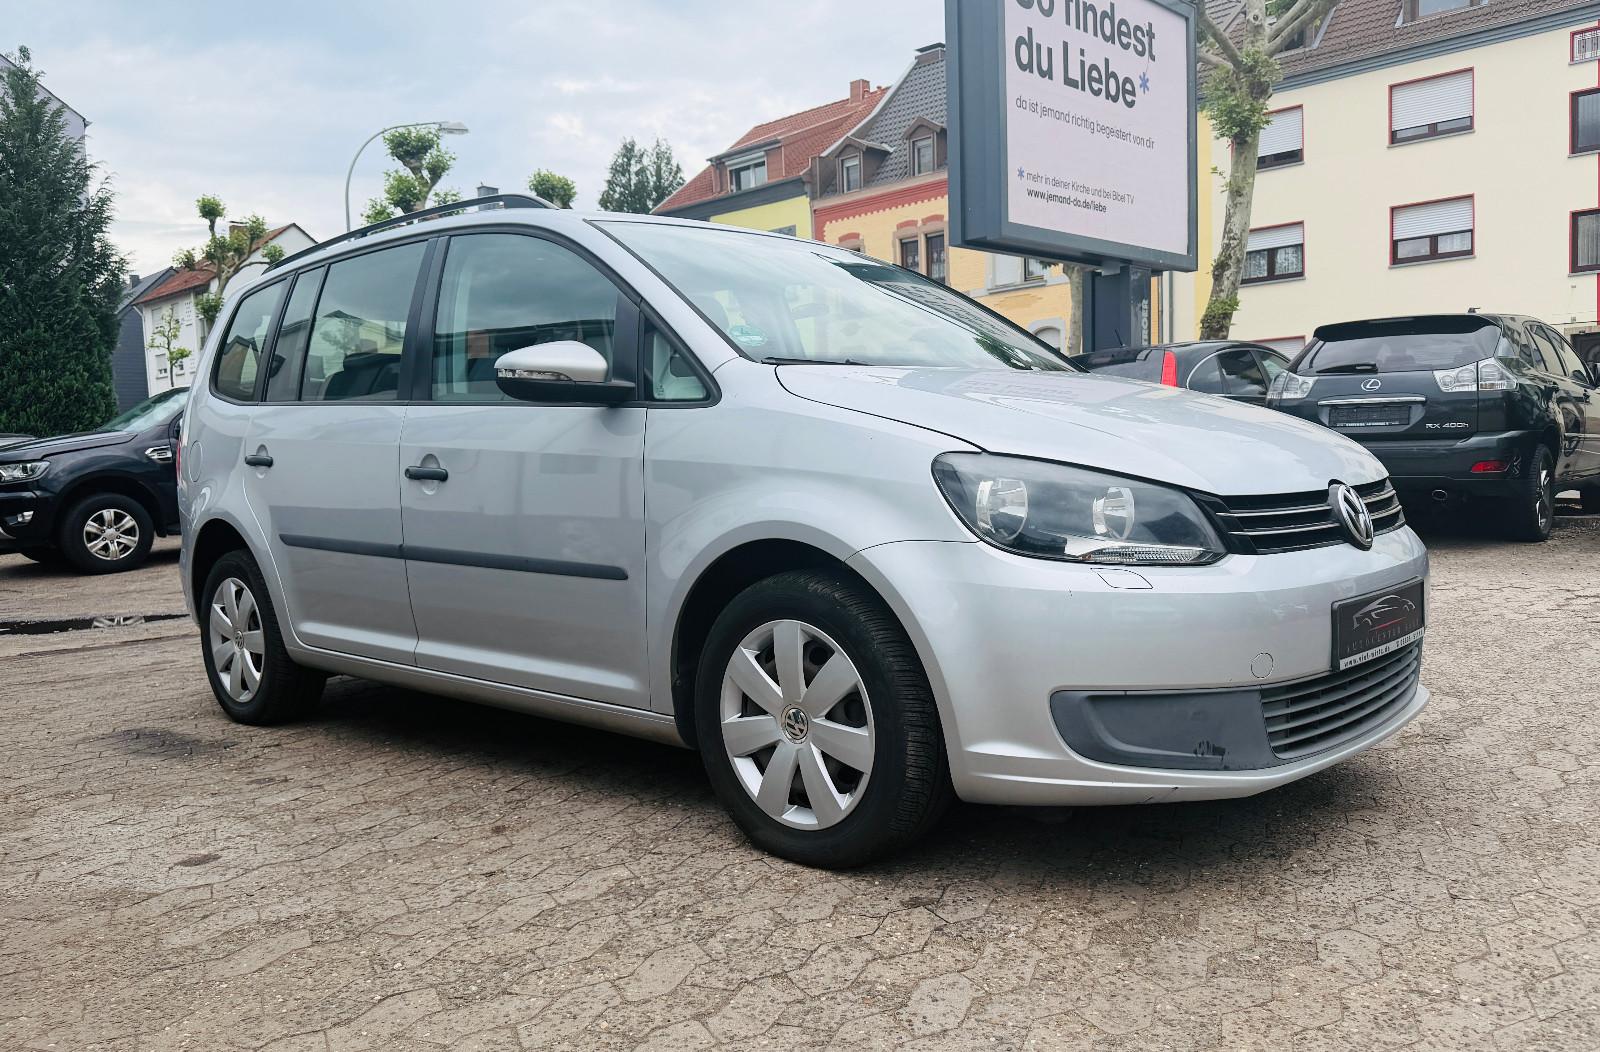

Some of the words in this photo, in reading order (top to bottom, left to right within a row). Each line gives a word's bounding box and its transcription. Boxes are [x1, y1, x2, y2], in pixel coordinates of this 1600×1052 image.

[1014, 26, 1053, 81] du
[1015, 95, 1028, 110] da
[1028, 98, 1039, 114] ist
[1039, 102, 1070, 124] jemand
[1071, 112, 1096, 134] richtig
[1096, 119, 1132, 143] begeistert
[1132, 133, 1145, 147] von
[1145, 136, 1156, 150] dir
[1026, 170, 1043, 184] mehr
[1044, 174, 1051, 186] in
[1051, 175, 1071, 190] deiner
[1071, 180, 1091, 195] Kirche
[1091, 186, 1102, 198] und
[1102, 187, 1112, 200] bei
[1112, 189, 1126, 203] Bibel
[1124, 192, 1135, 205] TV
[1026, 187, 1107, 213] www.jemand-da.de/liebe
[1425, 422, 1441, 430] RX
